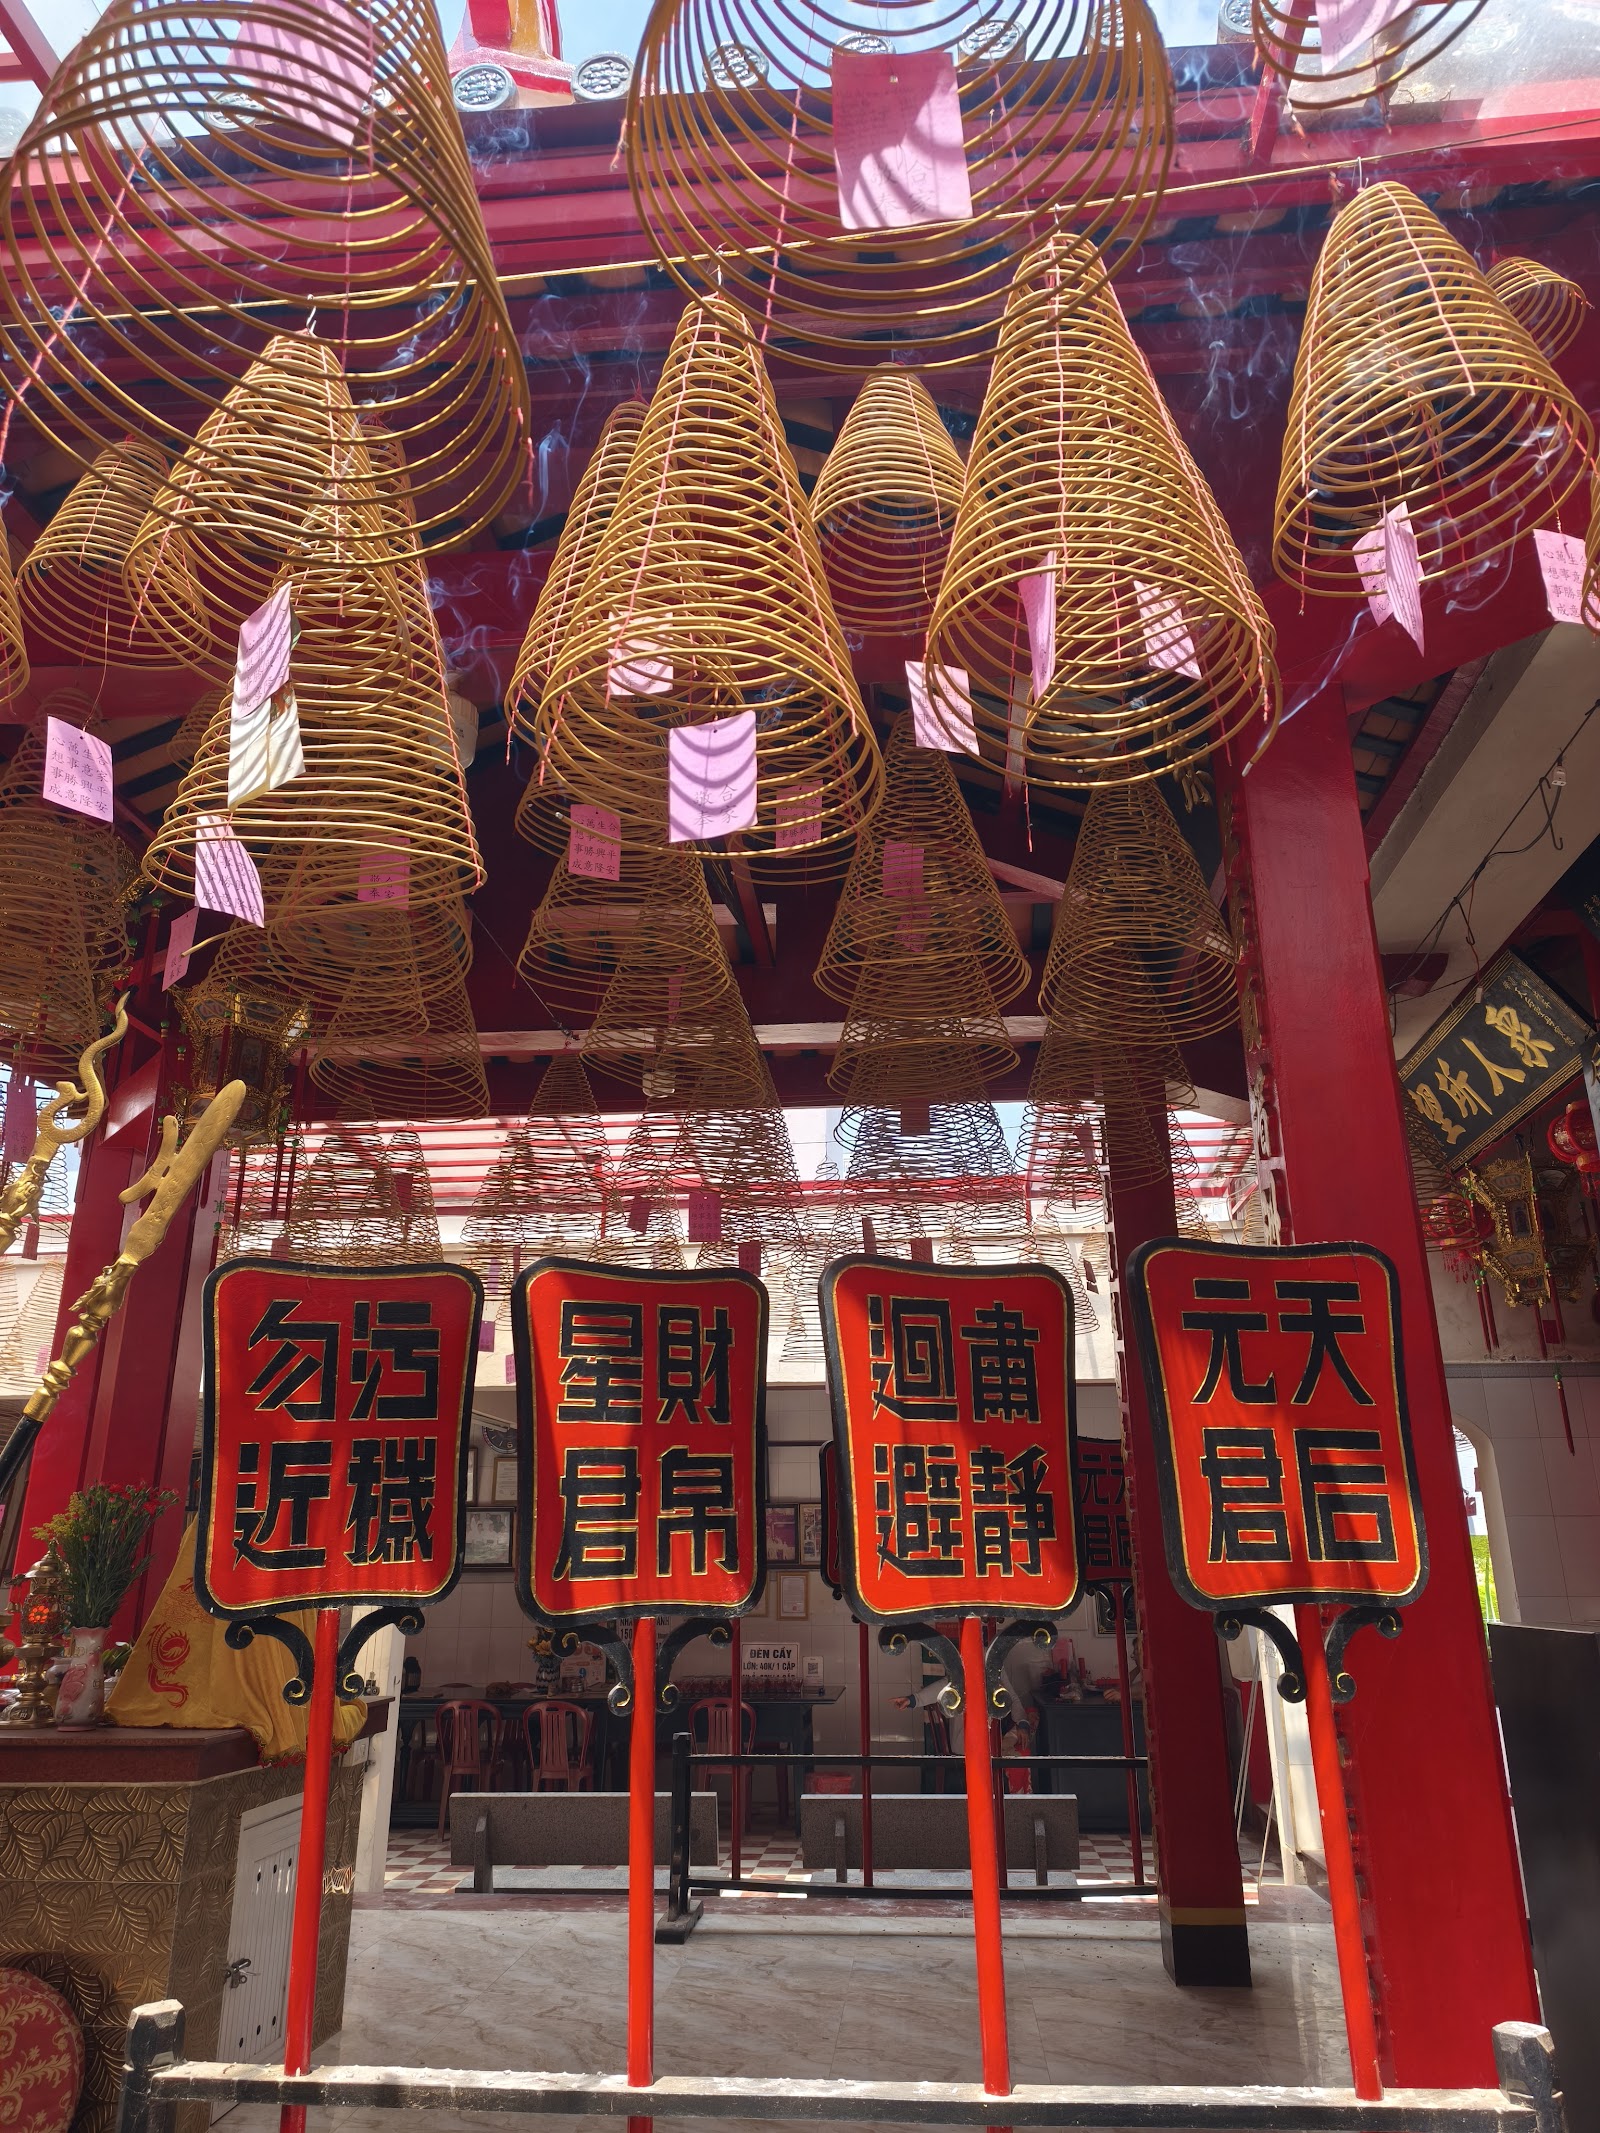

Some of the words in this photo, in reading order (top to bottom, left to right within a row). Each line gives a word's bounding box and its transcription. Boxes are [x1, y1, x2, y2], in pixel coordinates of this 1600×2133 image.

[1543, 550, 1570, 617] 心想事成
[49, 737, 65, 798] 心想事成
[65, 741, 80, 803] 萬事勝意
[80, 749, 95, 808] 生意興隆
[95, 754, 109, 814] 合家平安
[233, 1299, 342, 1571] 勿近
[552, 1300, 645, 1582] 星君
[656, 1303, 740, 1578] 財帛
[1181, 1277, 1294, 1565] 元君
[1275, 1280, 1399, 1564] 天后
